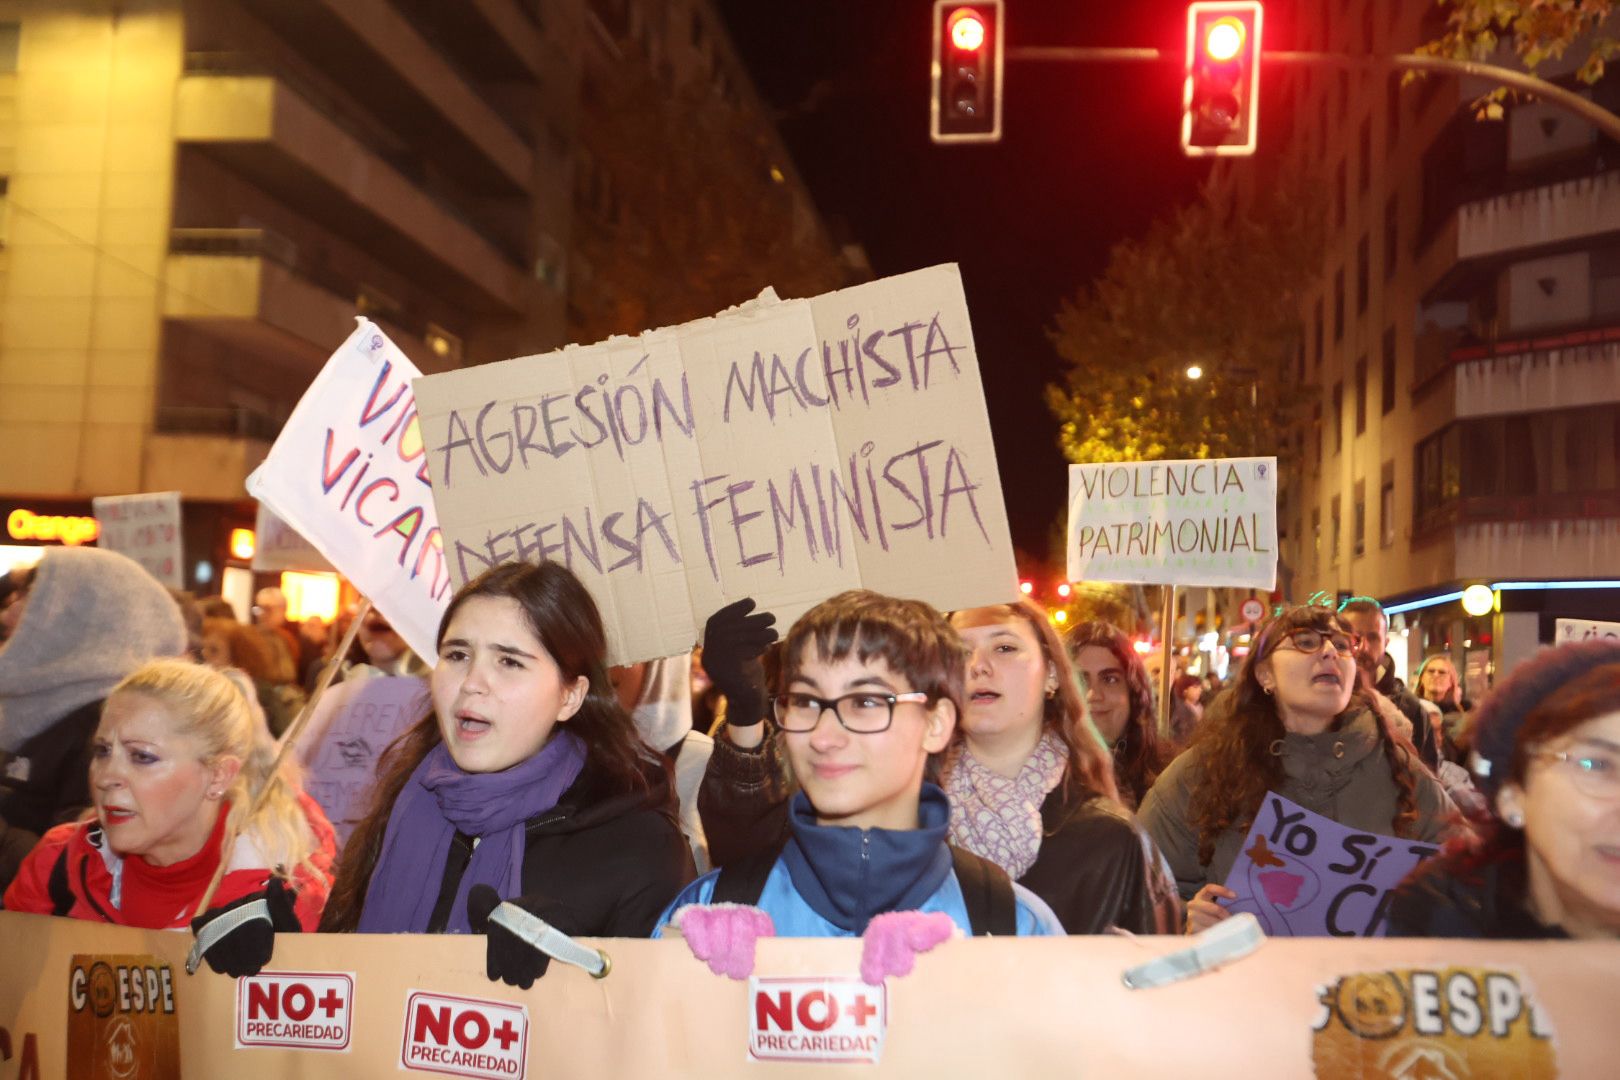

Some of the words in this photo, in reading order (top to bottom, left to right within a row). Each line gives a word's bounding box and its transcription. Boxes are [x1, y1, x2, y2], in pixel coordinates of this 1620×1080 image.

[437, 354, 695, 488] AGRESIÓN
[723, 311, 967, 425] MACHISTA
[1080, 460, 1245, 500] VIOLENCIA
[690, 440, 992, 582] FEMINISTA
[1079, 508, 1269, 559] PATRIMONIAL
[246, 1022, 344, 1041] PRECARIEDAD
[410, 1046, 518, 1074] PRECARIEDAD
